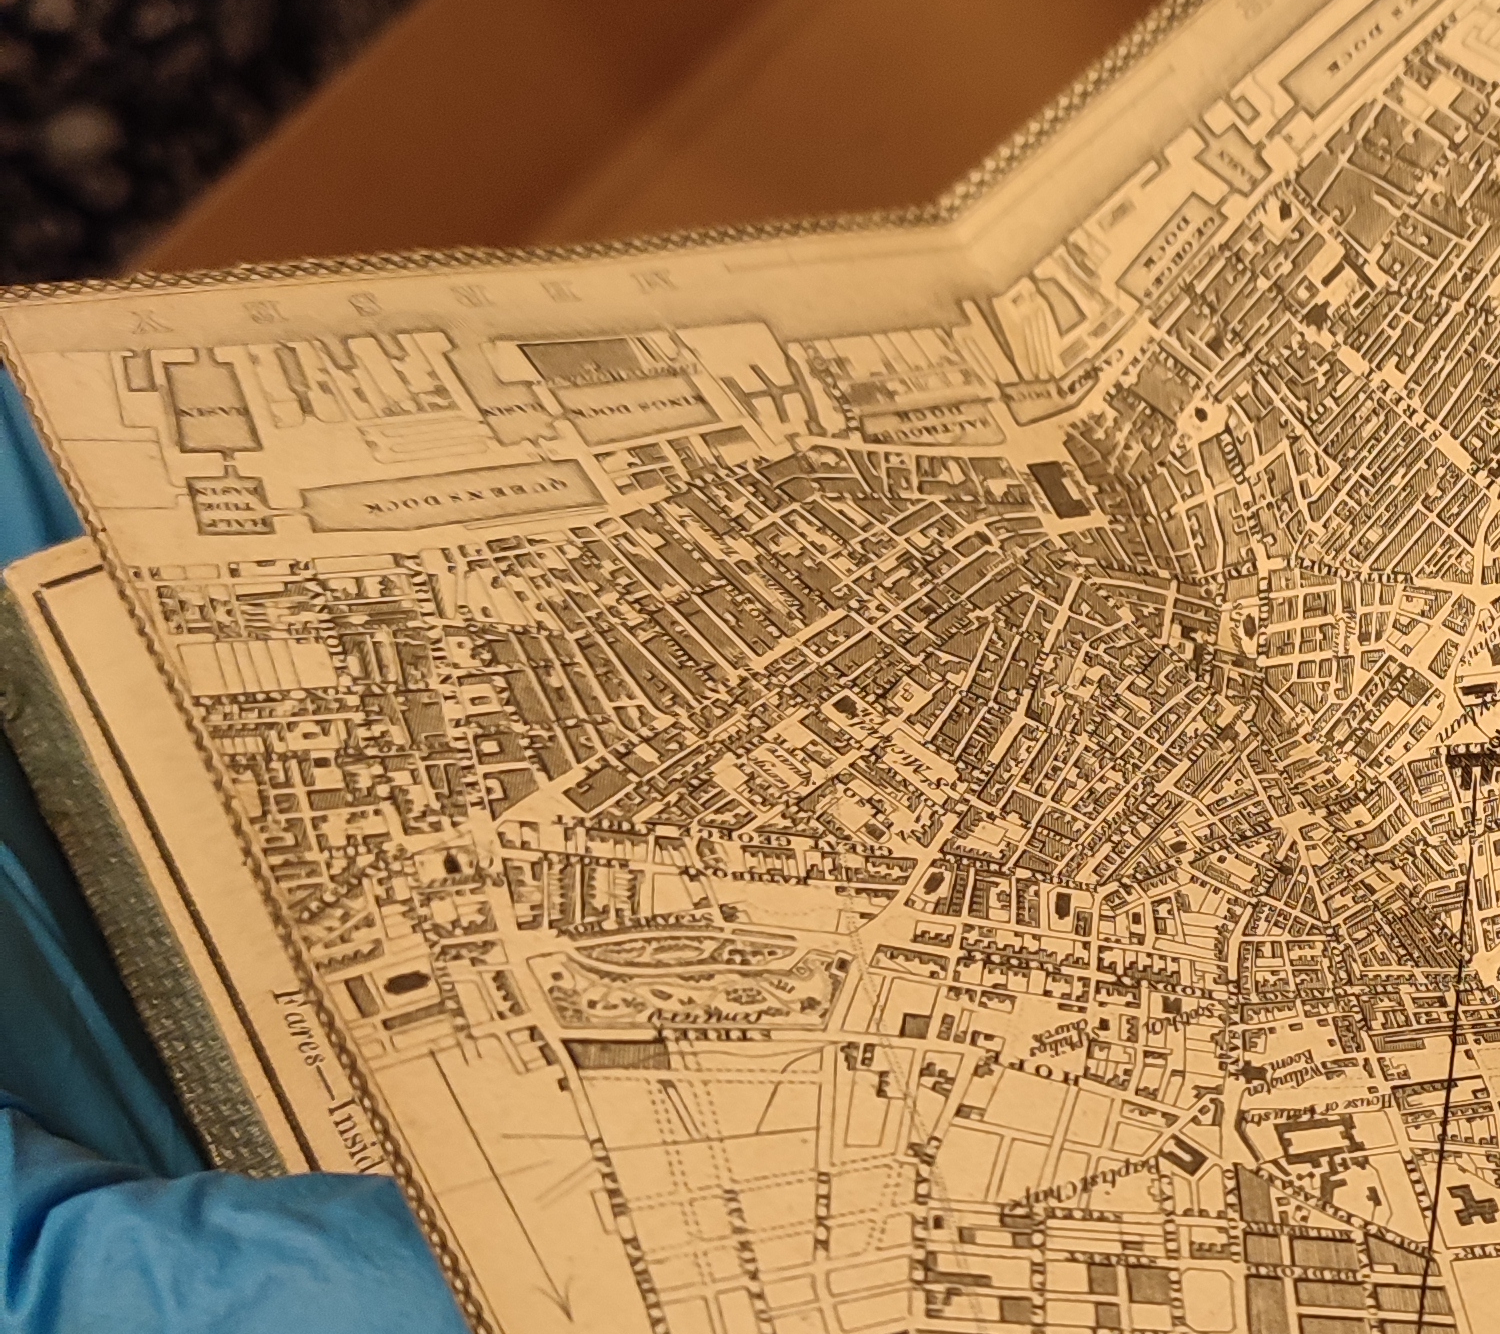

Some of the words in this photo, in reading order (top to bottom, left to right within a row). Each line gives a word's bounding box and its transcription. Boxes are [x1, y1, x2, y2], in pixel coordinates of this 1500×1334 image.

[362, 493, 442, 517] DOCK
[450, 477, 570, 506] QUEENS
[271, 988, 387, 1175] Fares—Insid
